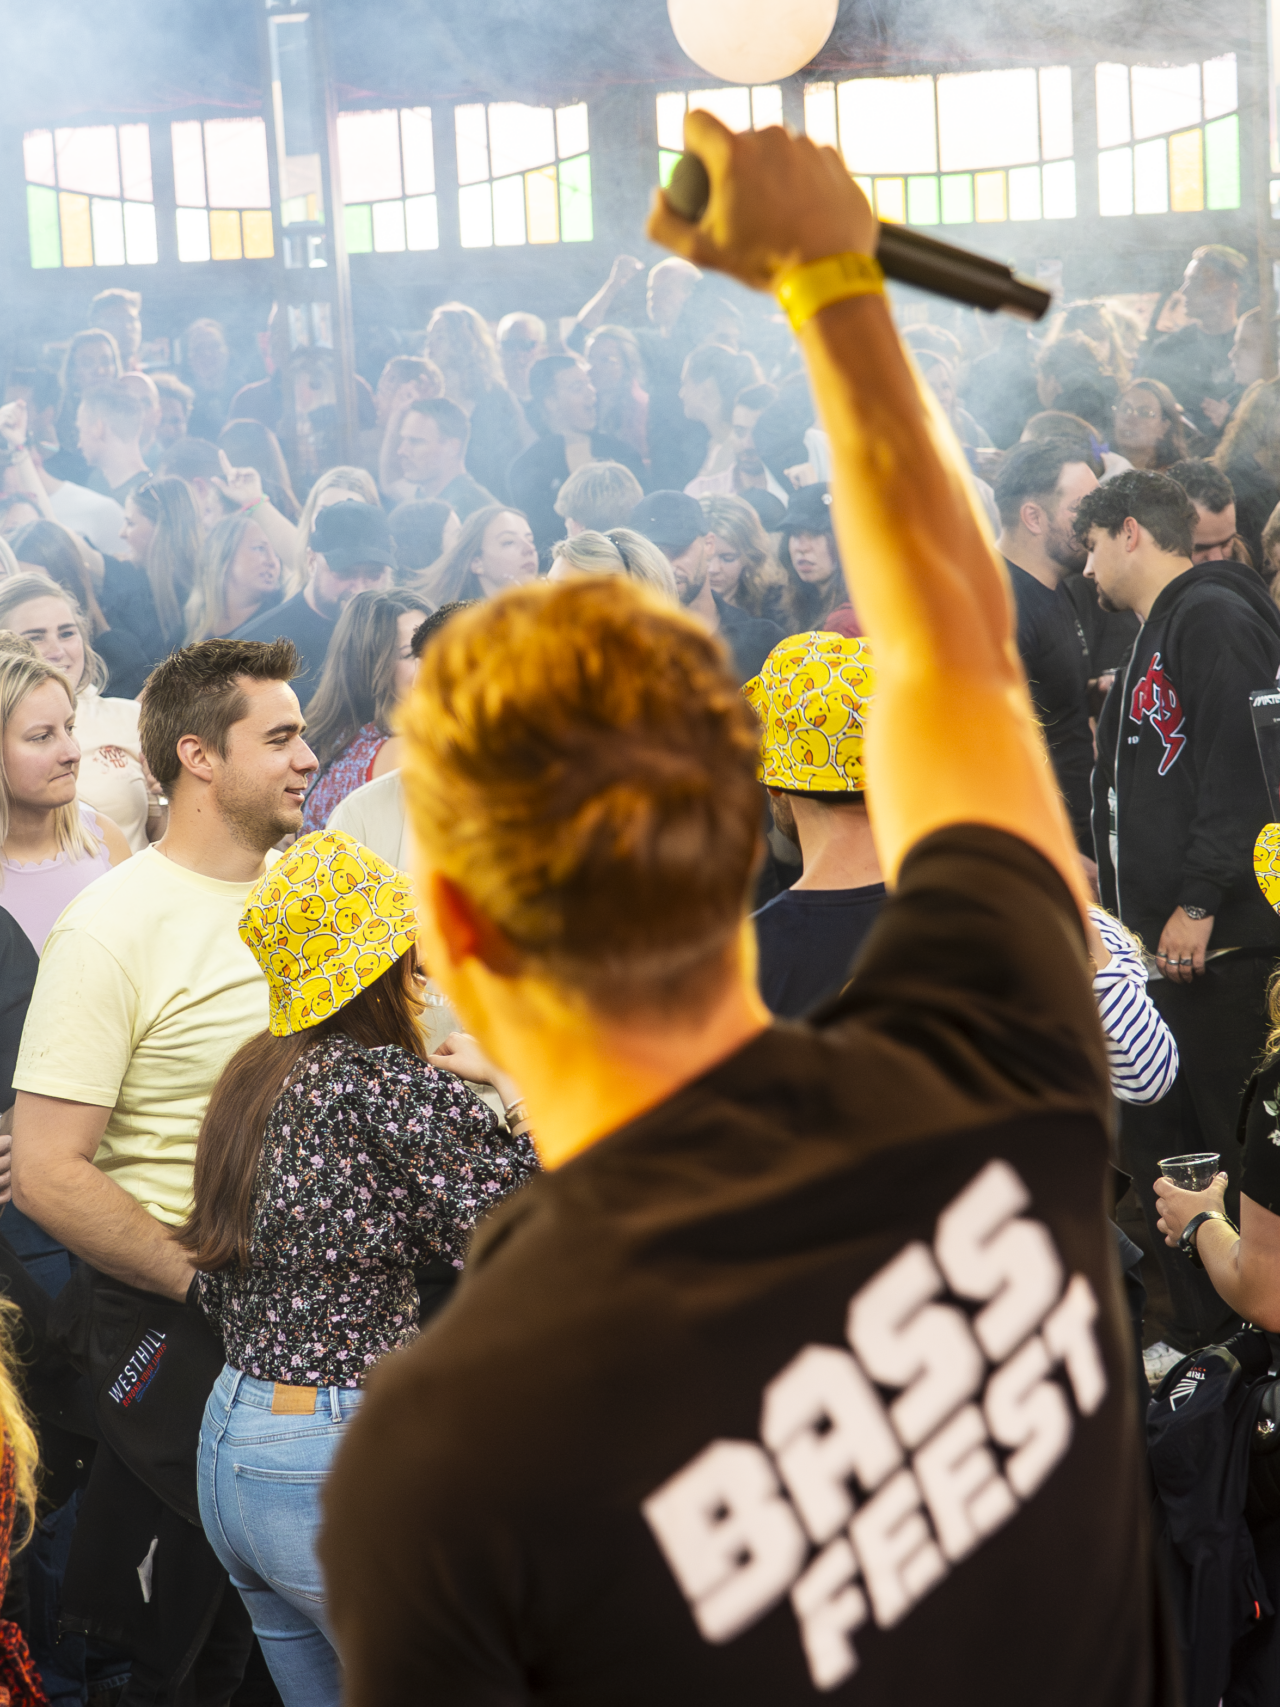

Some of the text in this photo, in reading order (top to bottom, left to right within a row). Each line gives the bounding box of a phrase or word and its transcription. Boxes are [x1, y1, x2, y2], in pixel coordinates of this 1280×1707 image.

[108, 1328, 166, 1404] WESTHILL
[122, 1381, 142, 1408] BEYOND
[140, 1364, 154, 1382] YOUR
[152, 1343, 167, 1366] LIMITS
[640, 1157, 1064, 1645] BASS
[790, 1270, 1109, 1692] FEEST
